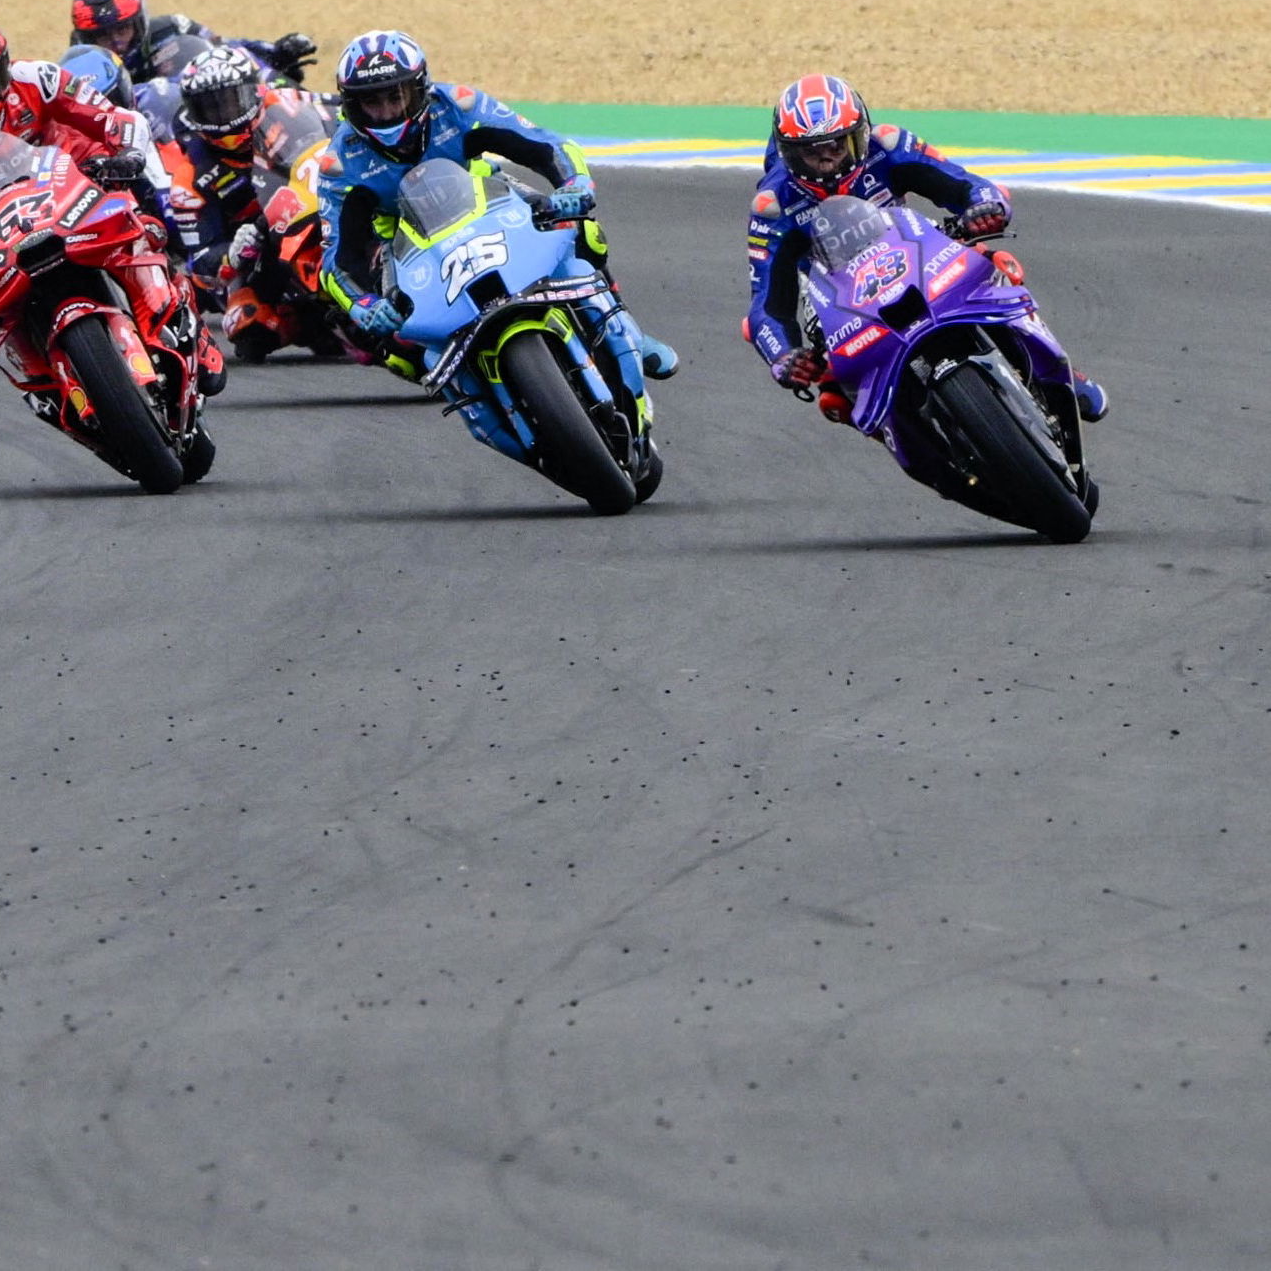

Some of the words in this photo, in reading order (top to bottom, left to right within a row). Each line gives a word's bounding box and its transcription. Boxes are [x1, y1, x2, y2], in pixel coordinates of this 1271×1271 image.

[357, 64, 397, 78] SHARK
[60, 189, 99, 228] Lenovo
[440, 230, 509, 307] 25
[846, 241, 890, 279] prima
[853, 248, 907, 306] 43
[923, 241, 963, 276] prima
[759, 324, 782, 355] prima
[825, 316, 863, 353] prima
[845, 327, 881, 357] MOTUL
